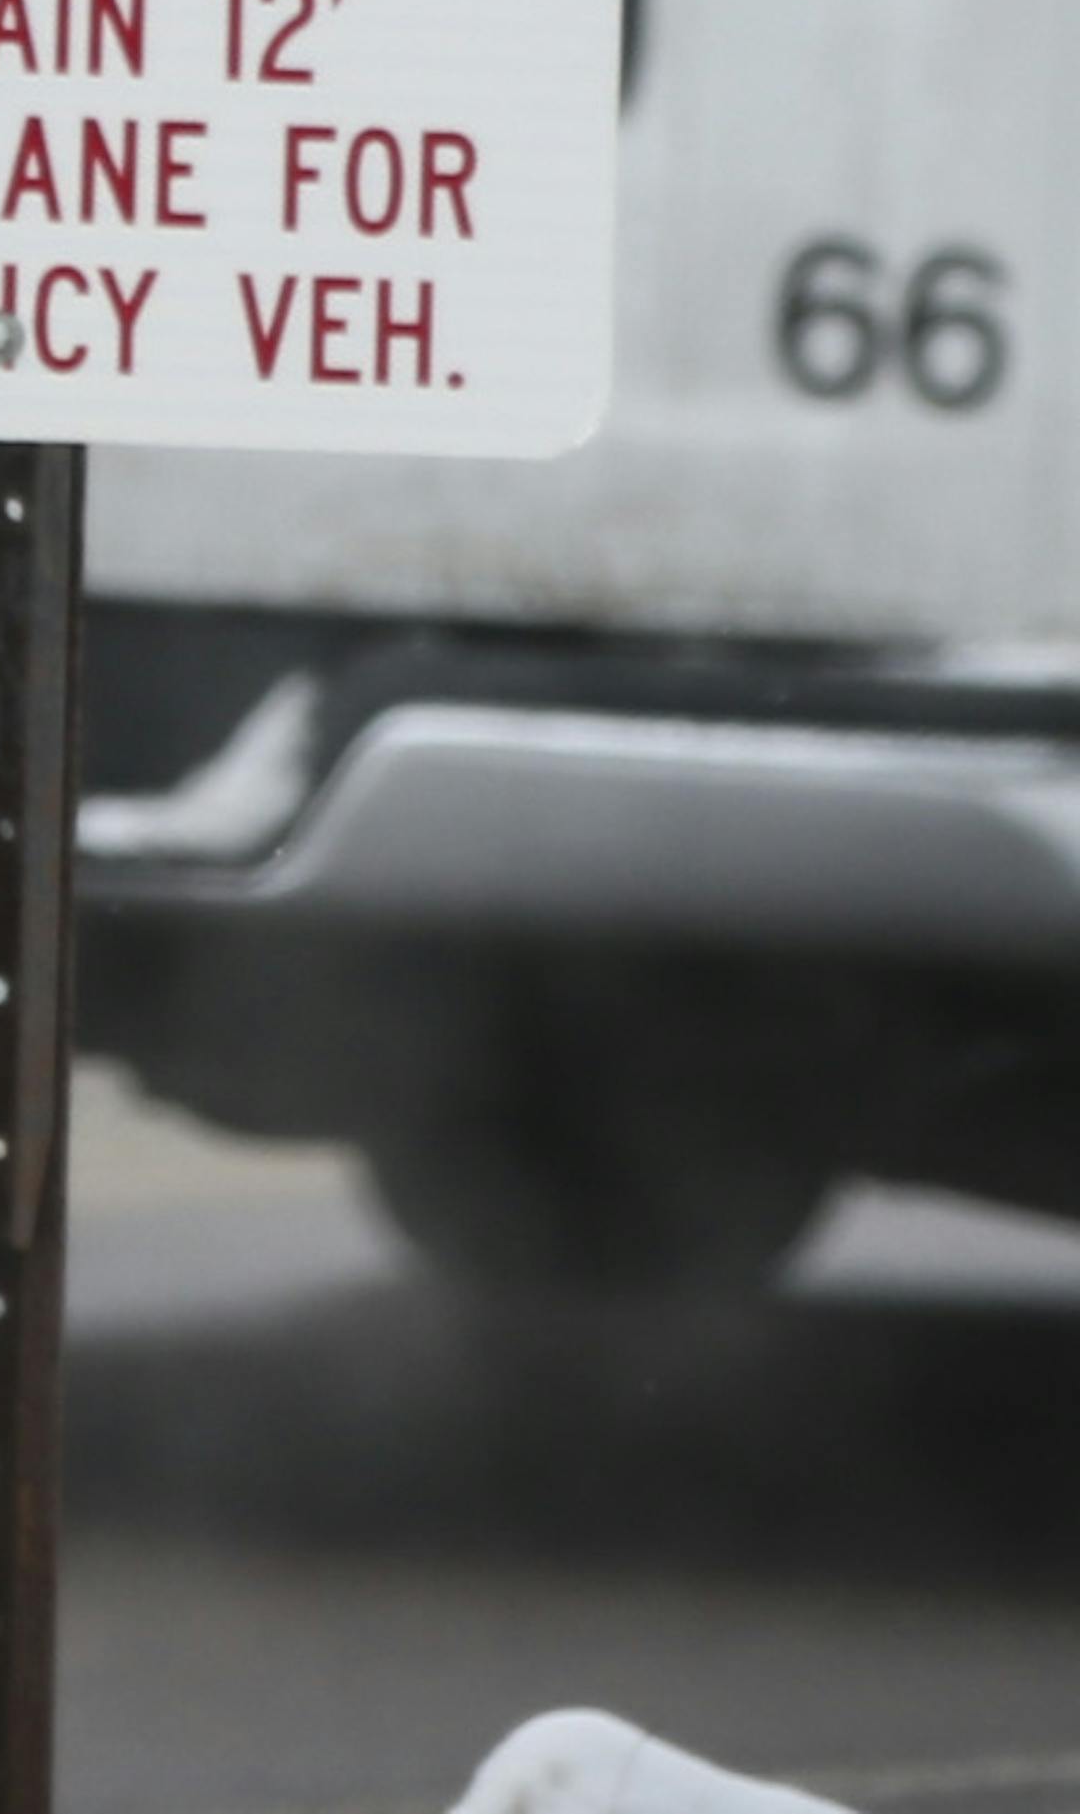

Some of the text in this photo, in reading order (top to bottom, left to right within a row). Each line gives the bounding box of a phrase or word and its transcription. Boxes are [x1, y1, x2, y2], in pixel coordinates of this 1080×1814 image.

[282, 124, 479, 237] FOR
[239, 273, 467, 391] VEH.
[771, 236, 1008, 415] 66
